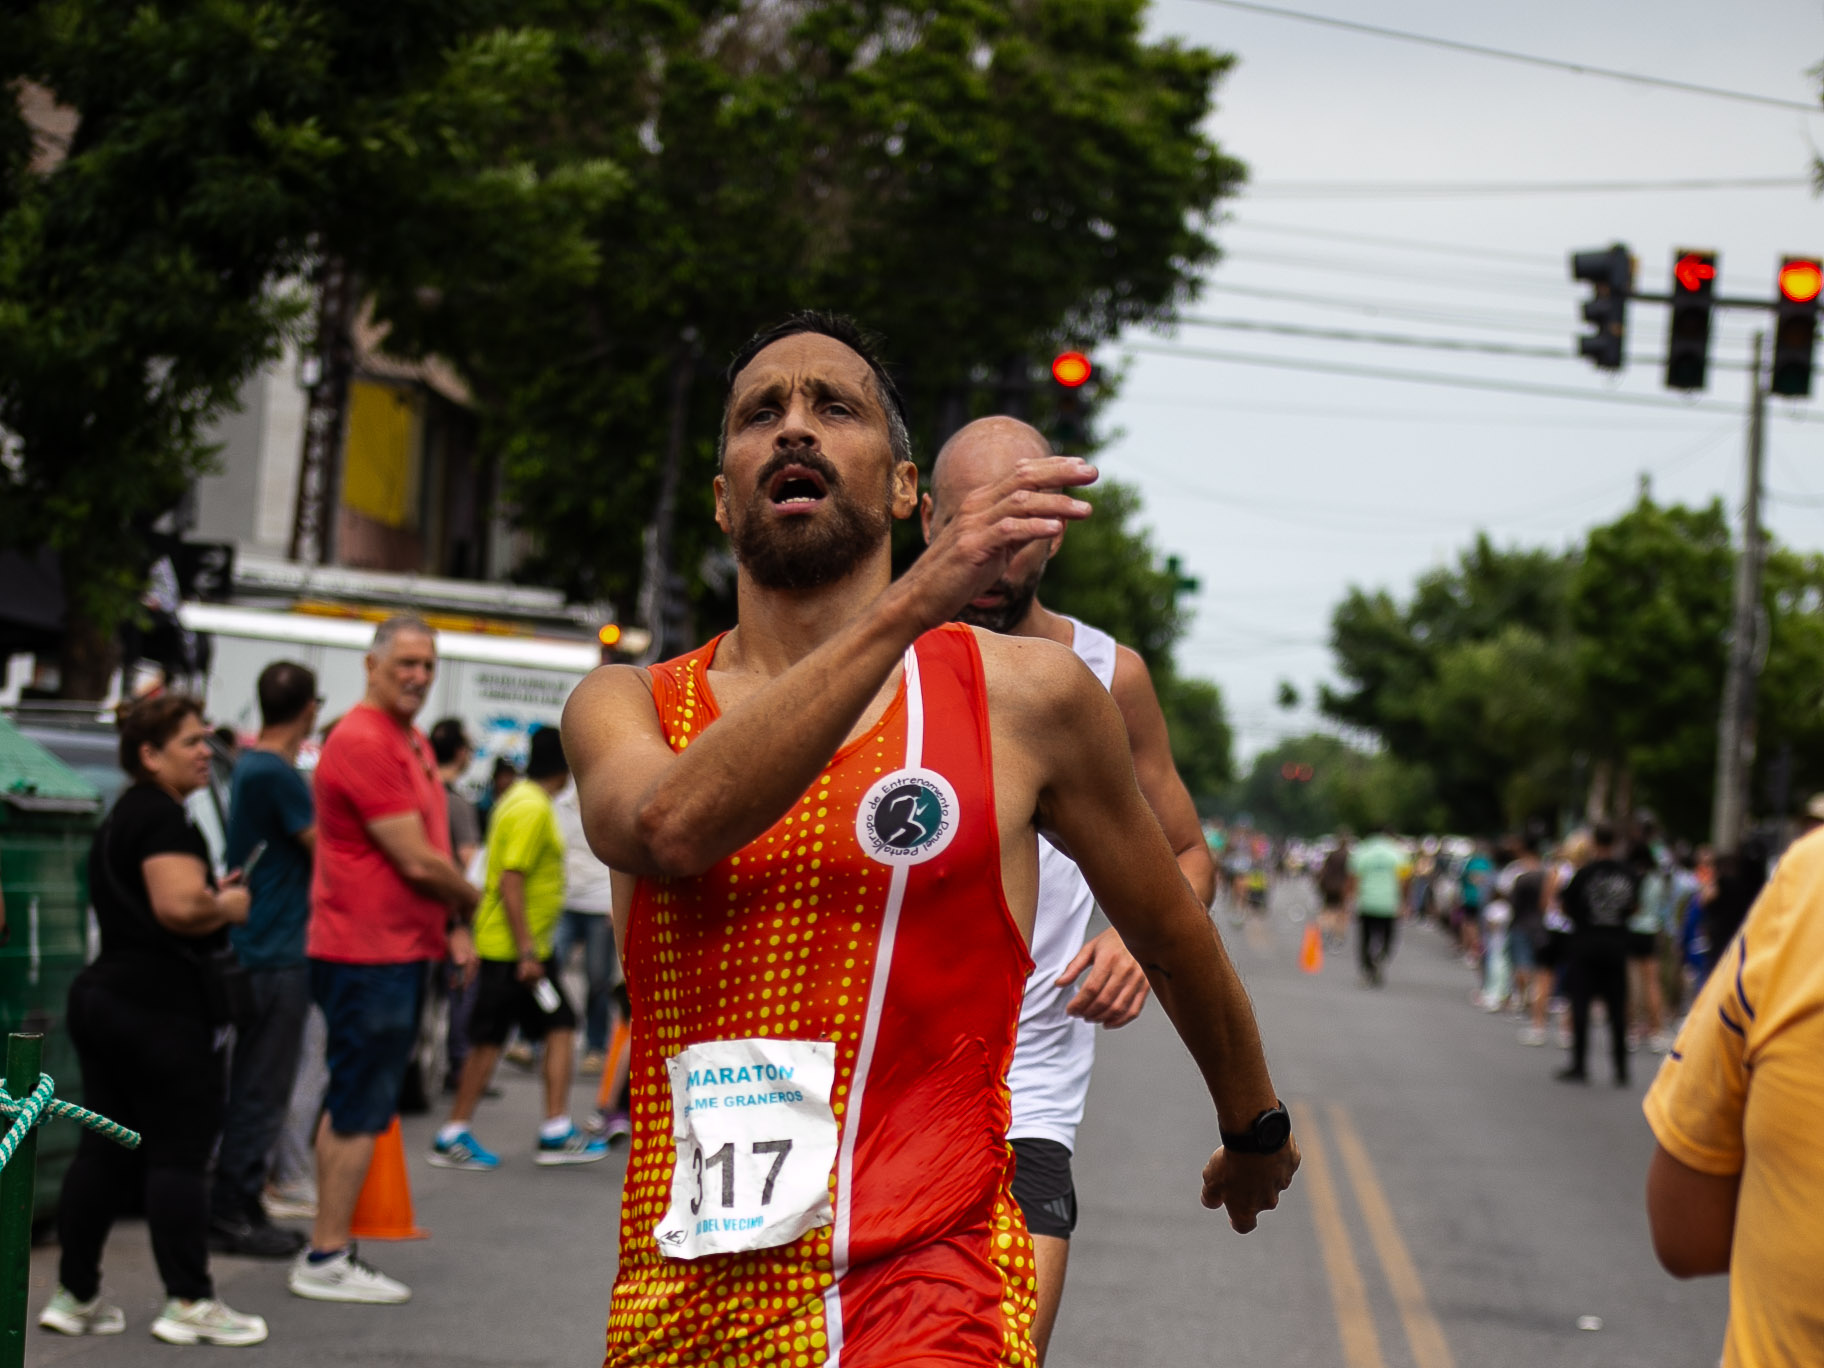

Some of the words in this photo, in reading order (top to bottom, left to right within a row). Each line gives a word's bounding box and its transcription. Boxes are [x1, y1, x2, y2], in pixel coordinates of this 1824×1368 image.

[868, 796, 880, 810] de
[881, 777, 950, 817] Entrenamiento
[866, 814, 884, 850] Grupo
[923, 821, 950, 851] Daniel
[685, 1063, 794, 1092] MARATON
[724, 1090, 804, 1108] GRANEROS
[690, 1138, 793, 1216] 317
